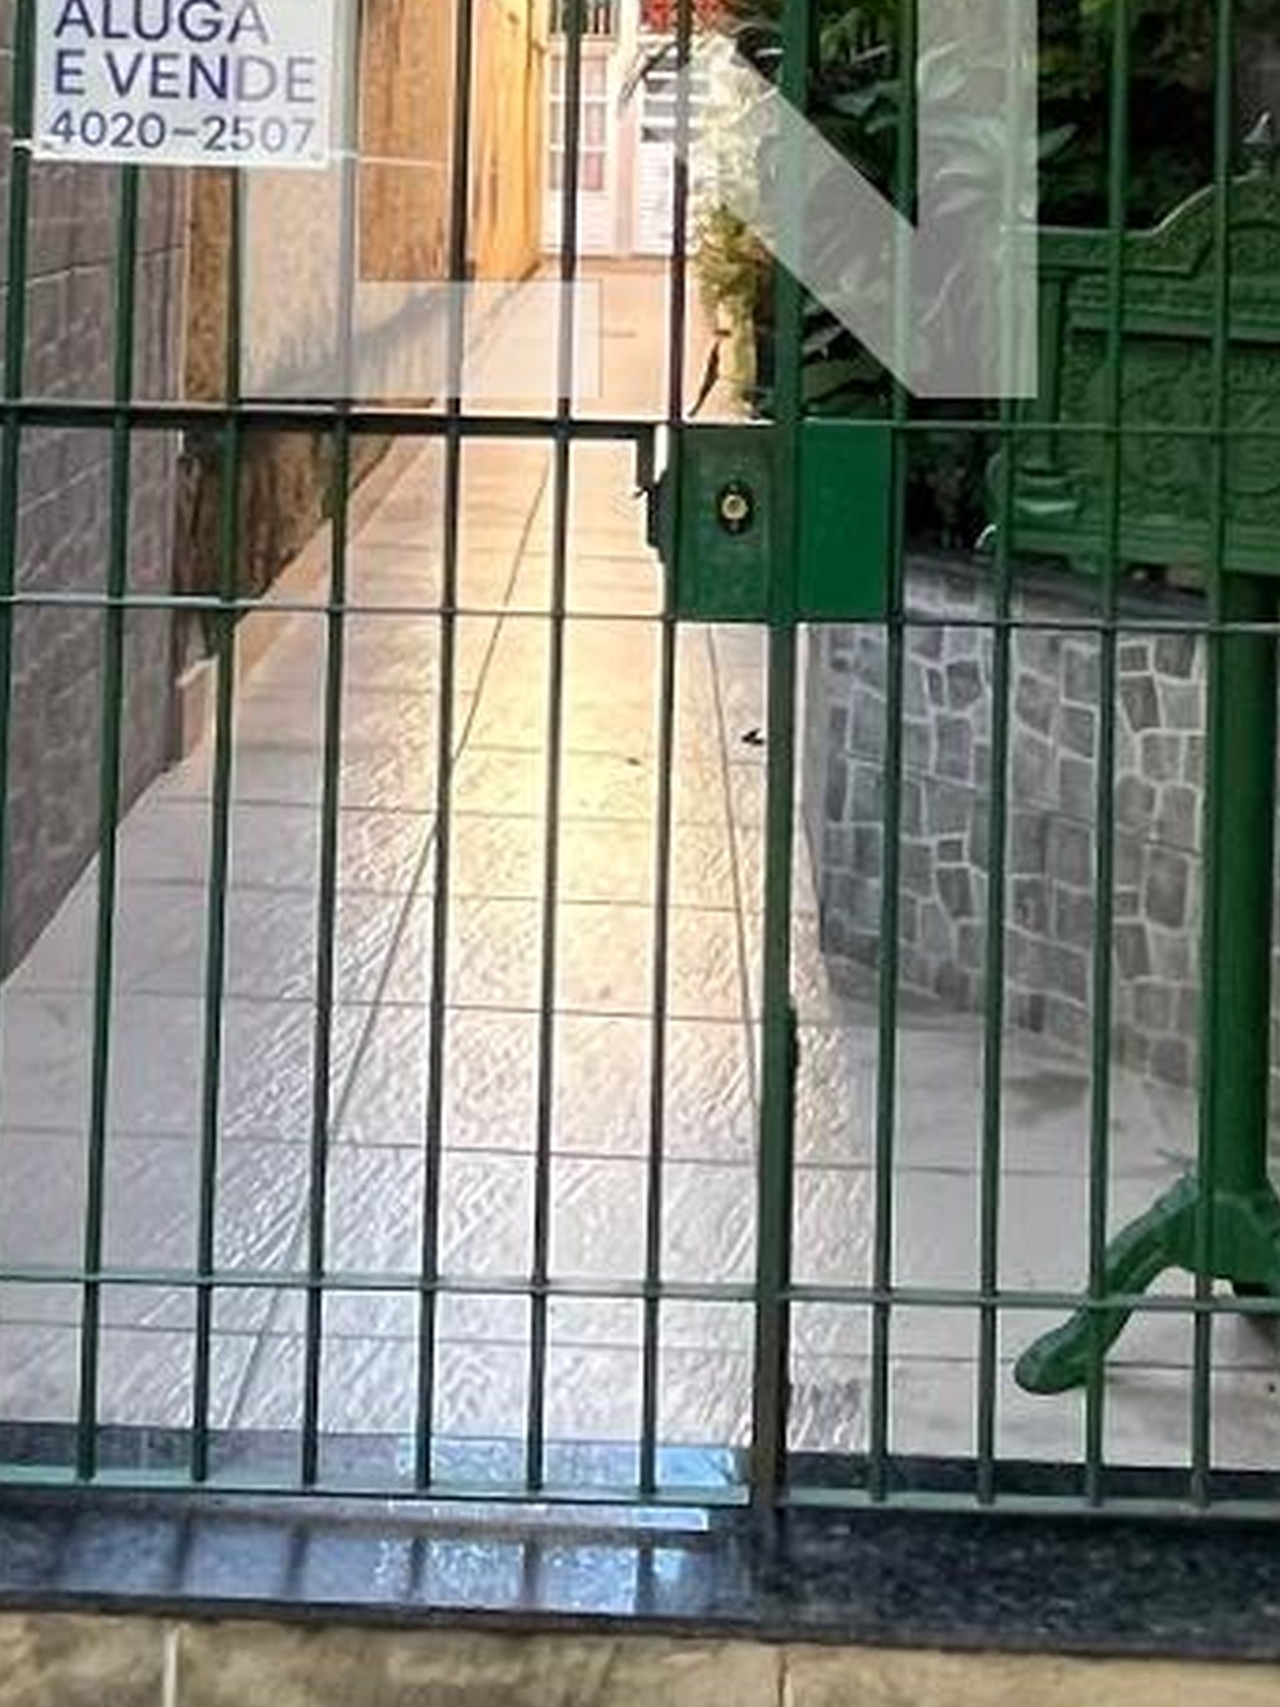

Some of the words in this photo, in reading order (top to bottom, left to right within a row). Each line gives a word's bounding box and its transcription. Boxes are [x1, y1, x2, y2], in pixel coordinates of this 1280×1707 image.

[54, 48, 86, 96] E
[104, 51, 317, 103] VENDE
[51, 109, 316, 153] 4020-2507
